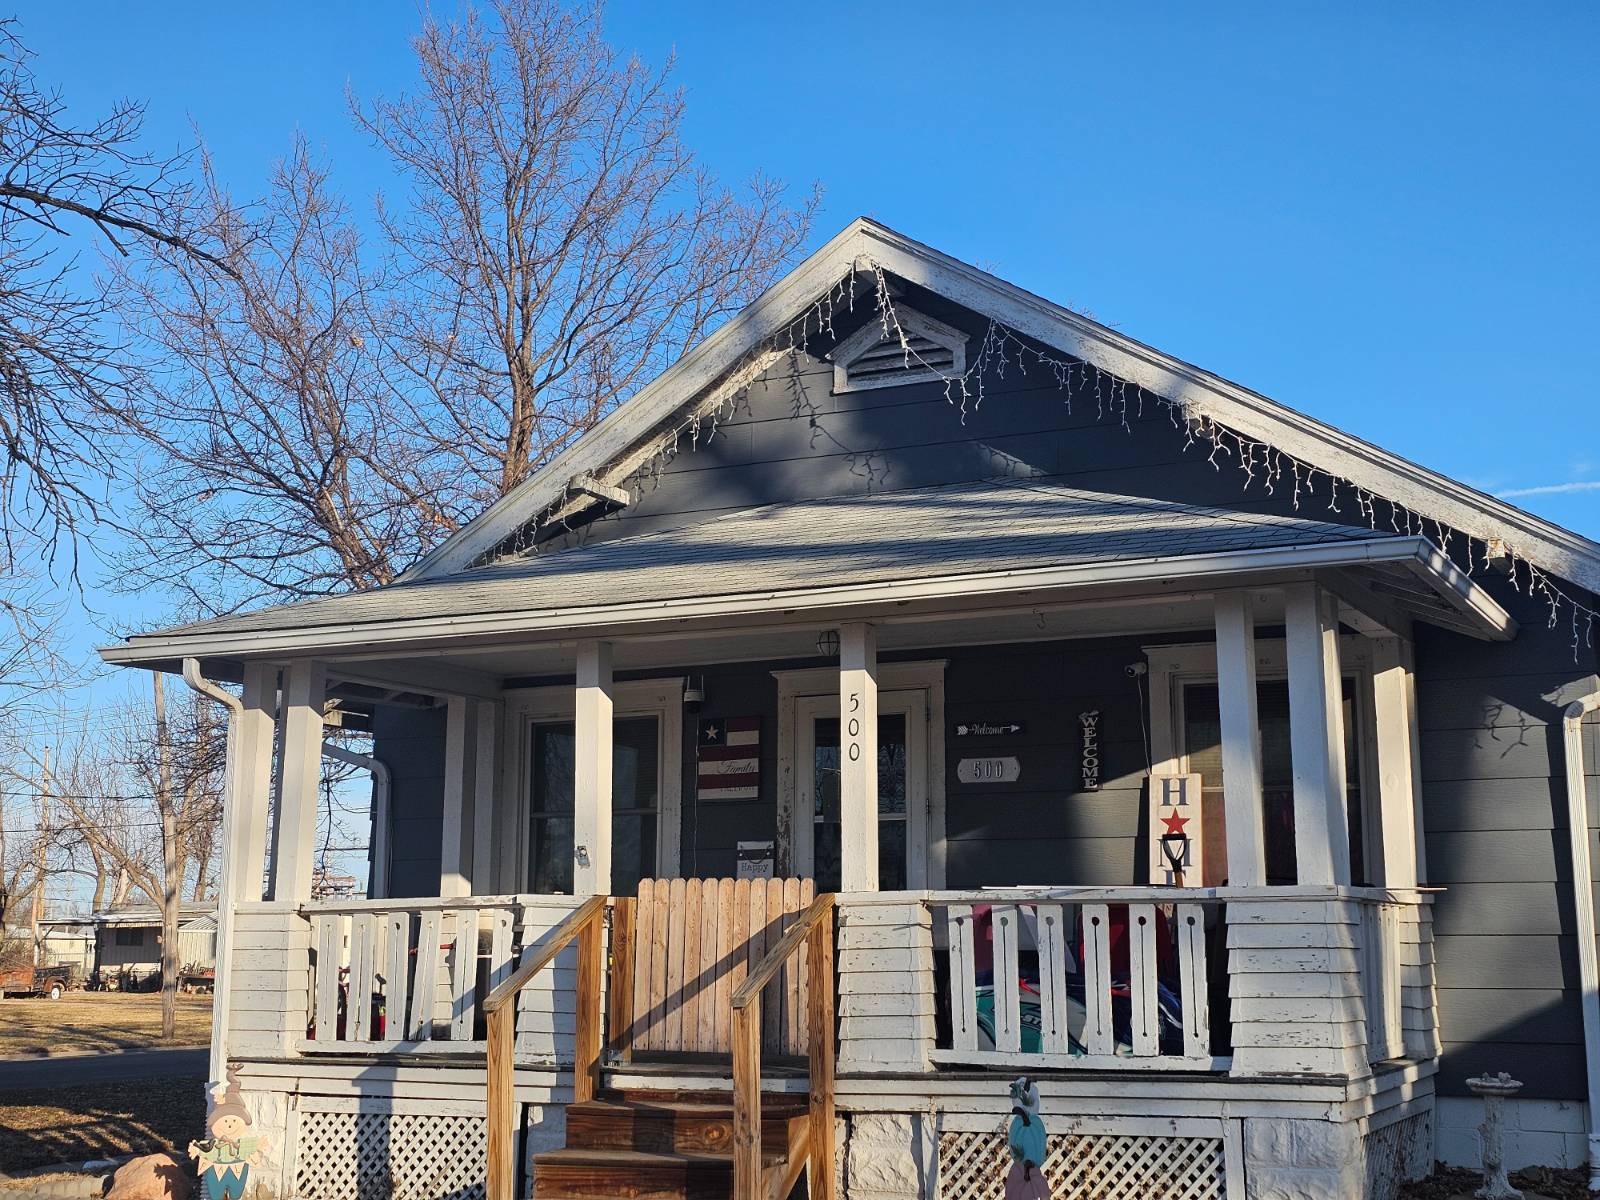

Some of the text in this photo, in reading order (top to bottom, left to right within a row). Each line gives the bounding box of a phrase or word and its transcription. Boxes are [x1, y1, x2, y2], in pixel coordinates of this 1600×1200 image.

[848, 692, 860, 762] 500
[971, 722, 1004, 736] Welcome
[1081, 717, 1099, 789] WELCOME
[718, 761, 756, 774] Family
[973, 760, 1003, 779] 500
